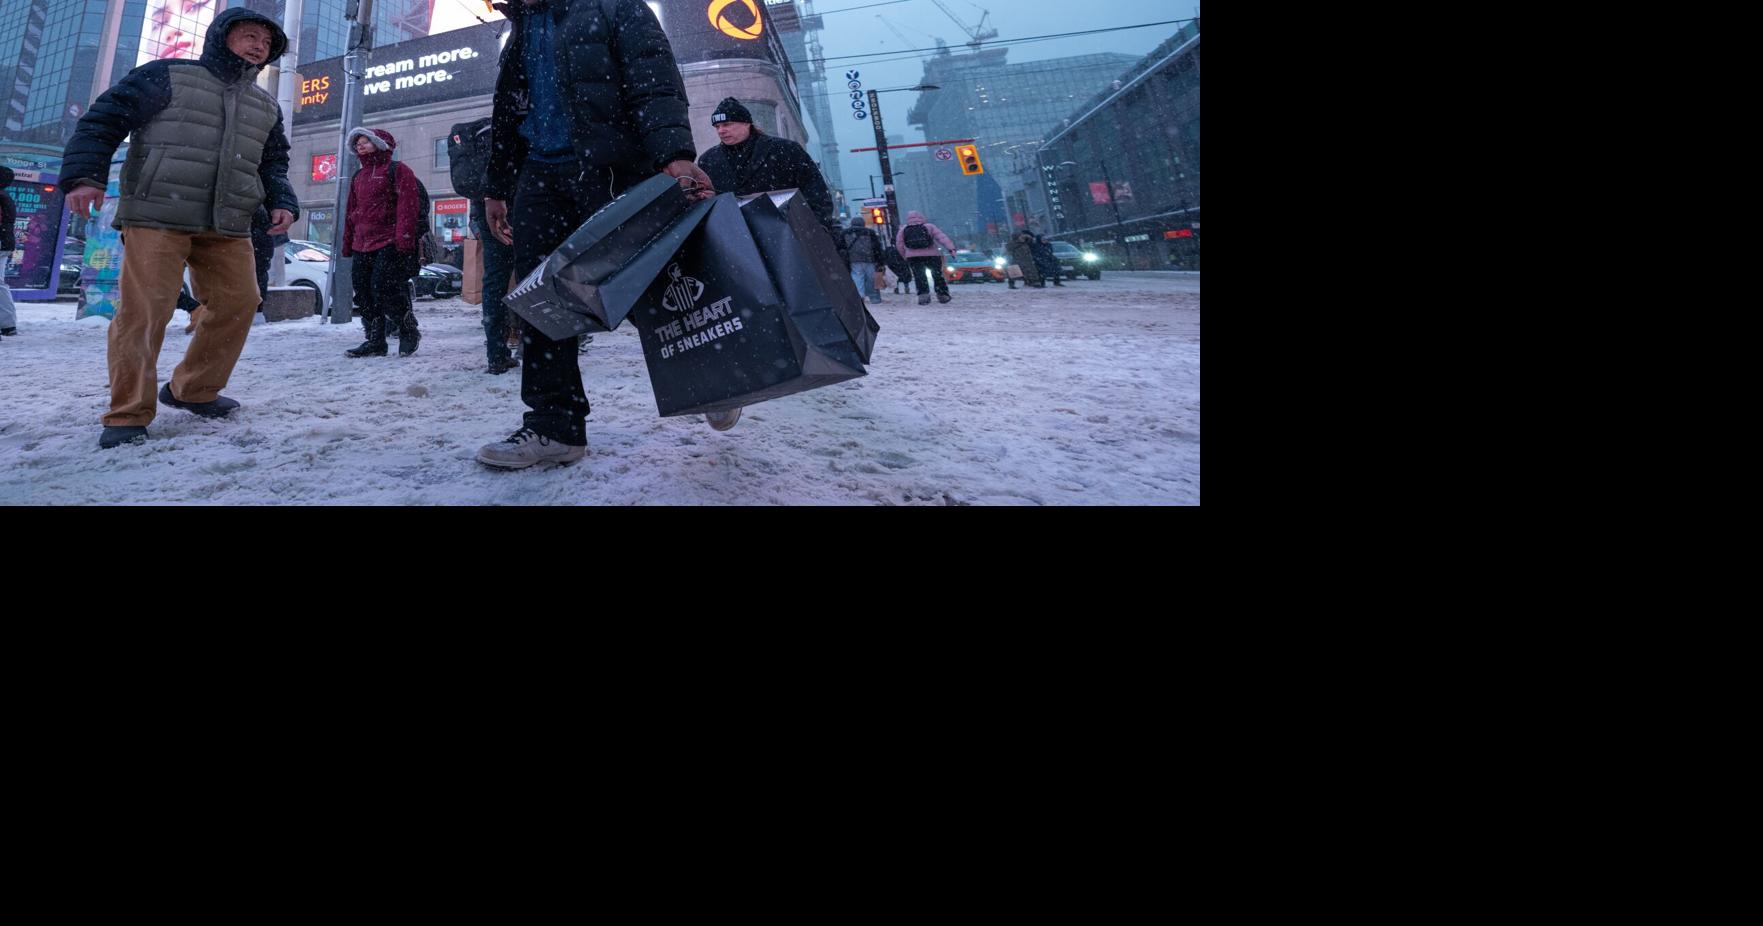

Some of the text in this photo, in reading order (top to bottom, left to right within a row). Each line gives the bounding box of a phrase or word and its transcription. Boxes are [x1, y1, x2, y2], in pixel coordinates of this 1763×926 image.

[419, 46, 479, 67] more.
[302, 75, 330, 93] ERS
[395, 69, 453, 90] more.
[6, 157, 47, 169] Yonge St
[1042, 164, 1065, 219] WINNERS
[310, 211, 326, 220] fido
[654, 295, 733, 343] THE HEART
[660, 316, 744, 359] OF SNEAKERS
